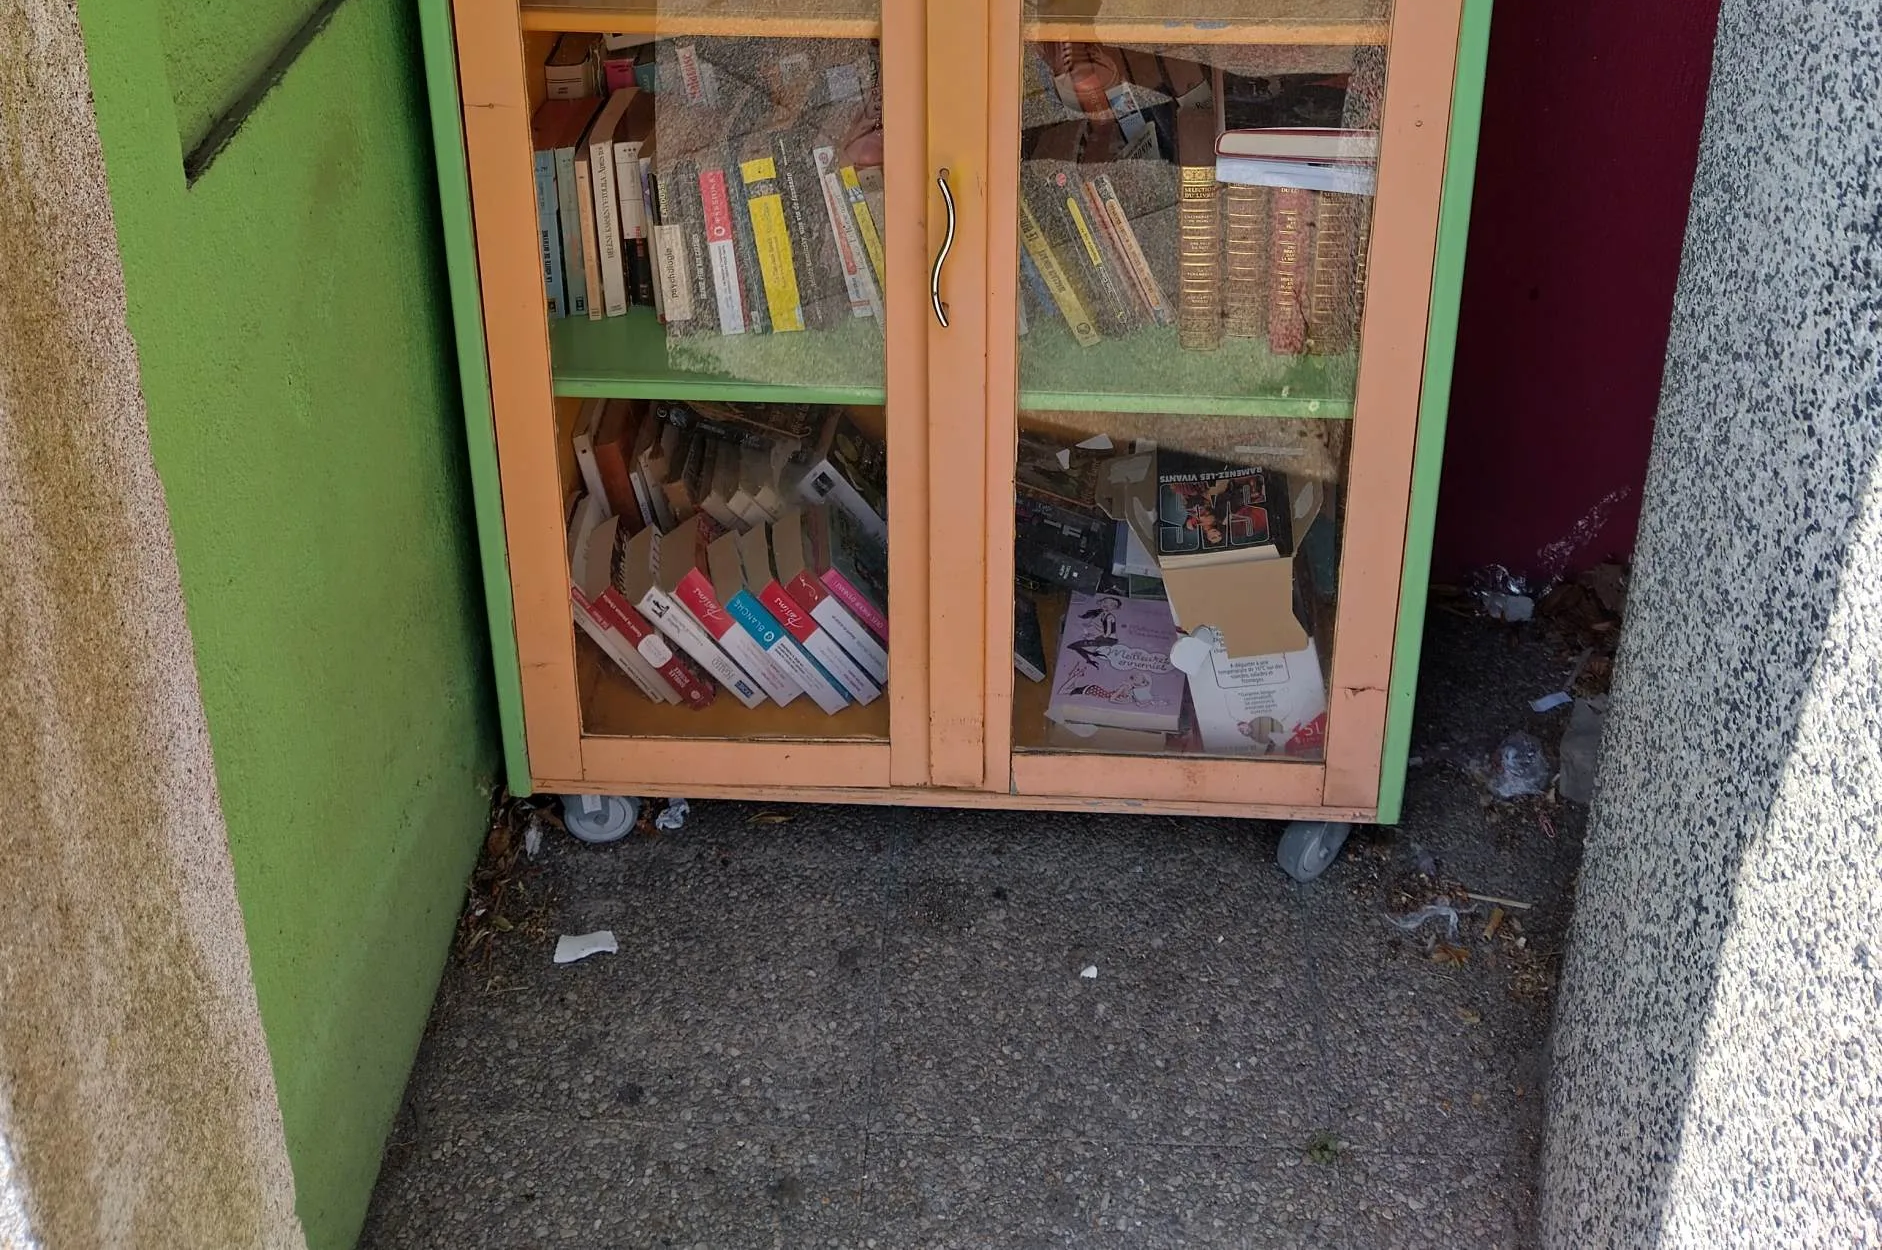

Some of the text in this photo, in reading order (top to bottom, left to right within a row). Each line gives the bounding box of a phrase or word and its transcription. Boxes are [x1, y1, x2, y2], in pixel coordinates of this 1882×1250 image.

[1159, 472, 1198, 484] VIVANTS
[692, 587, 726, 624] Passions
[733, 598, 765, 634] BLANCHE
[773, 596, 804, 629] Passions
